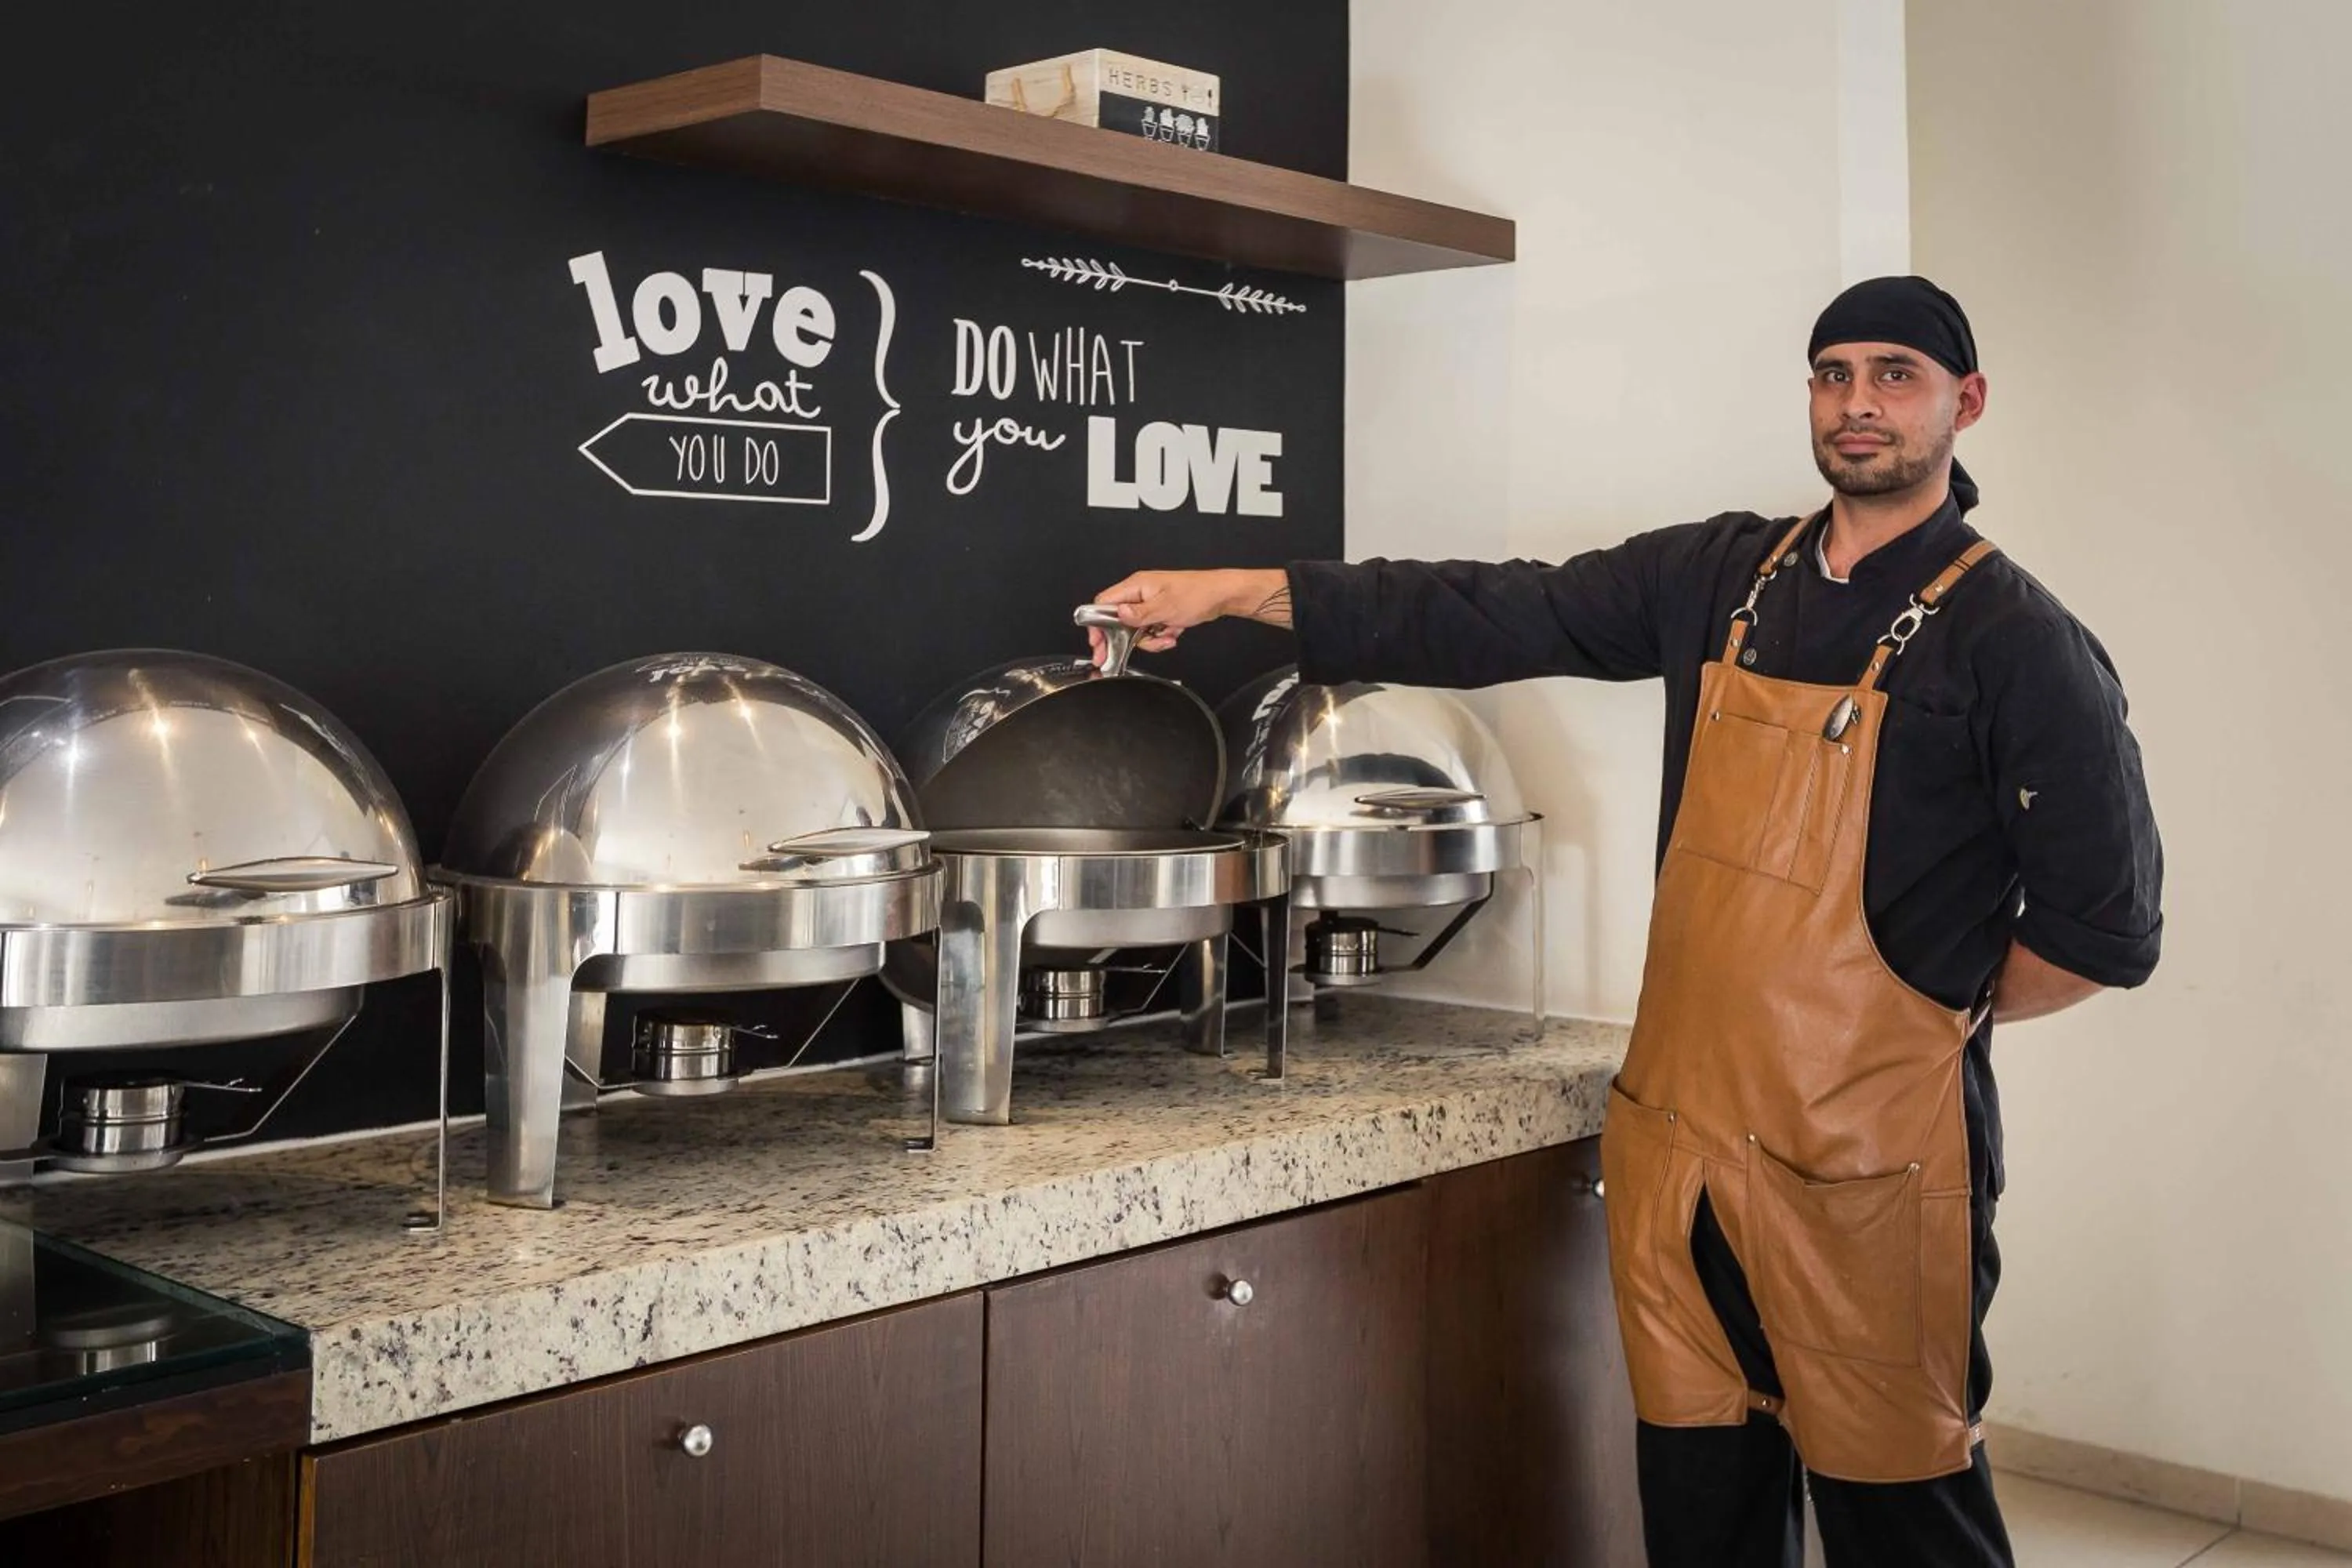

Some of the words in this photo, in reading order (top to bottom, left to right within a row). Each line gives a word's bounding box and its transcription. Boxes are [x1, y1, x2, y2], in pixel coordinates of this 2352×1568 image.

[1109, 67, 1173, 96] HERBS
[568, 251, 836, 373] love
[641, 357, 821, 418] what
[952, 318, 1017, 400] DO
[1029, 327, 1144, 405] WHAT
[669, 434, 725, 484] YOU
[745, 437, 779, 486] DO
[946, 418, 1066, 495] you
[1087, 416, 1283, 517] LOVE
